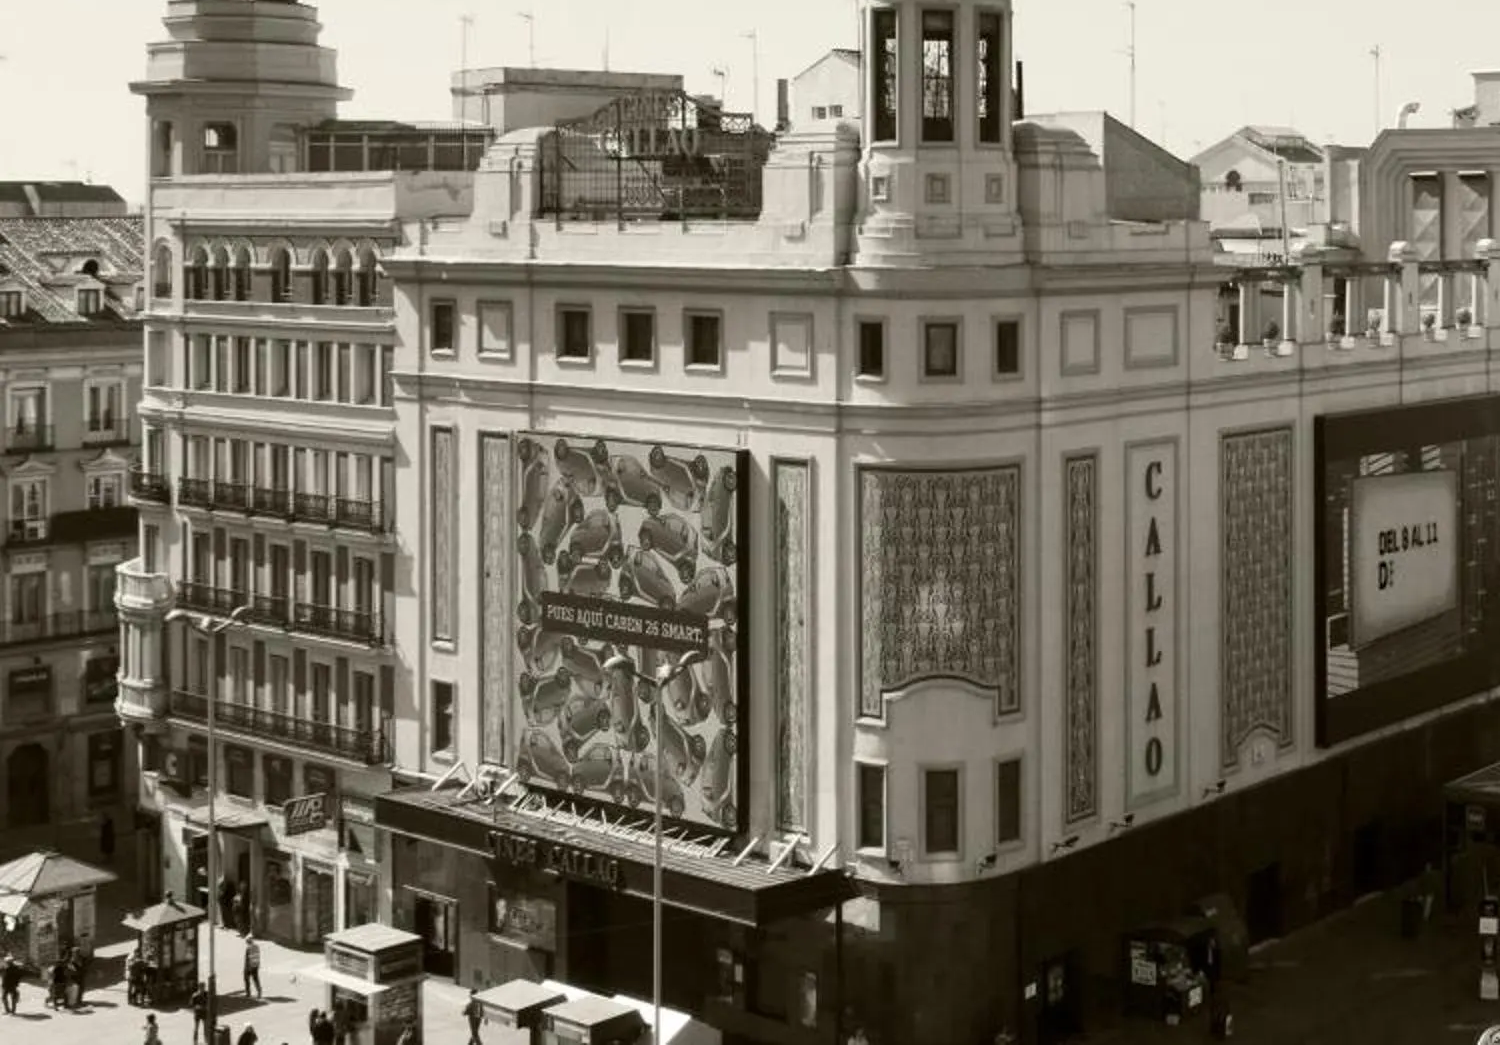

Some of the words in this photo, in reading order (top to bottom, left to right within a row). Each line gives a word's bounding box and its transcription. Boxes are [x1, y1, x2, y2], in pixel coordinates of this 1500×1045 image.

[1379, 530, 1400, 555] DEL
[1411, 525, 1425, 548] AL
[1426, 522, 1439, 545] 11
[547, 604, 575, 623] PUES
[576, 606, 604, 628] AQUÍ
[605, 613, 643, 634] CABEN
[645, 620, 660, 636] 26
[662, 621, 704, 643] SMART.
[1145, 461, 1163, 777] CALLAO
